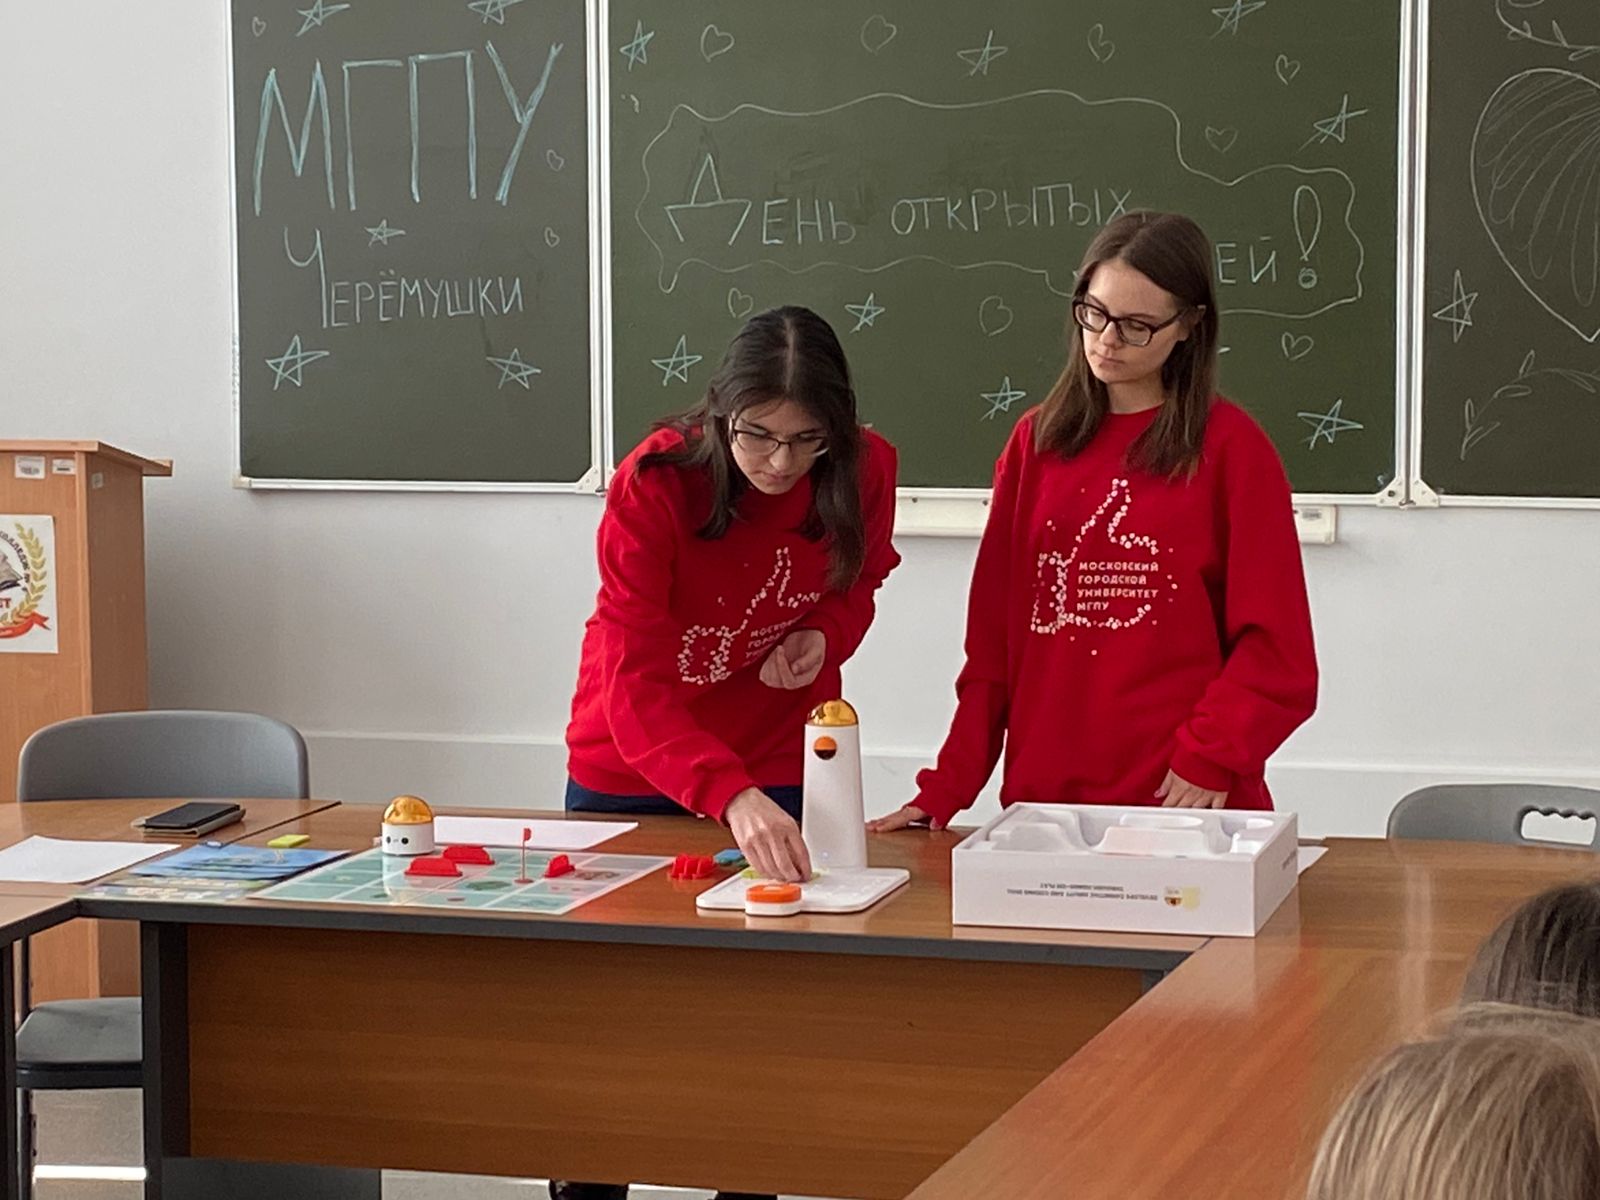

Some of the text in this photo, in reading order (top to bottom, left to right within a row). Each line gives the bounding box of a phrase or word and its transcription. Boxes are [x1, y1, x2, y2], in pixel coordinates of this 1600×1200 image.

[253, 40, 564, 217] МГПУ
[1078, 561, 1159, 572] МОСКОВСКИЙ
[1078, 575, 1147, 585] ГОРОДСКОЙ
[1077, 588, 1159, 599] УНИВЕРСИТЕТ
[1076, 601, 1109, 612] МГПУ
